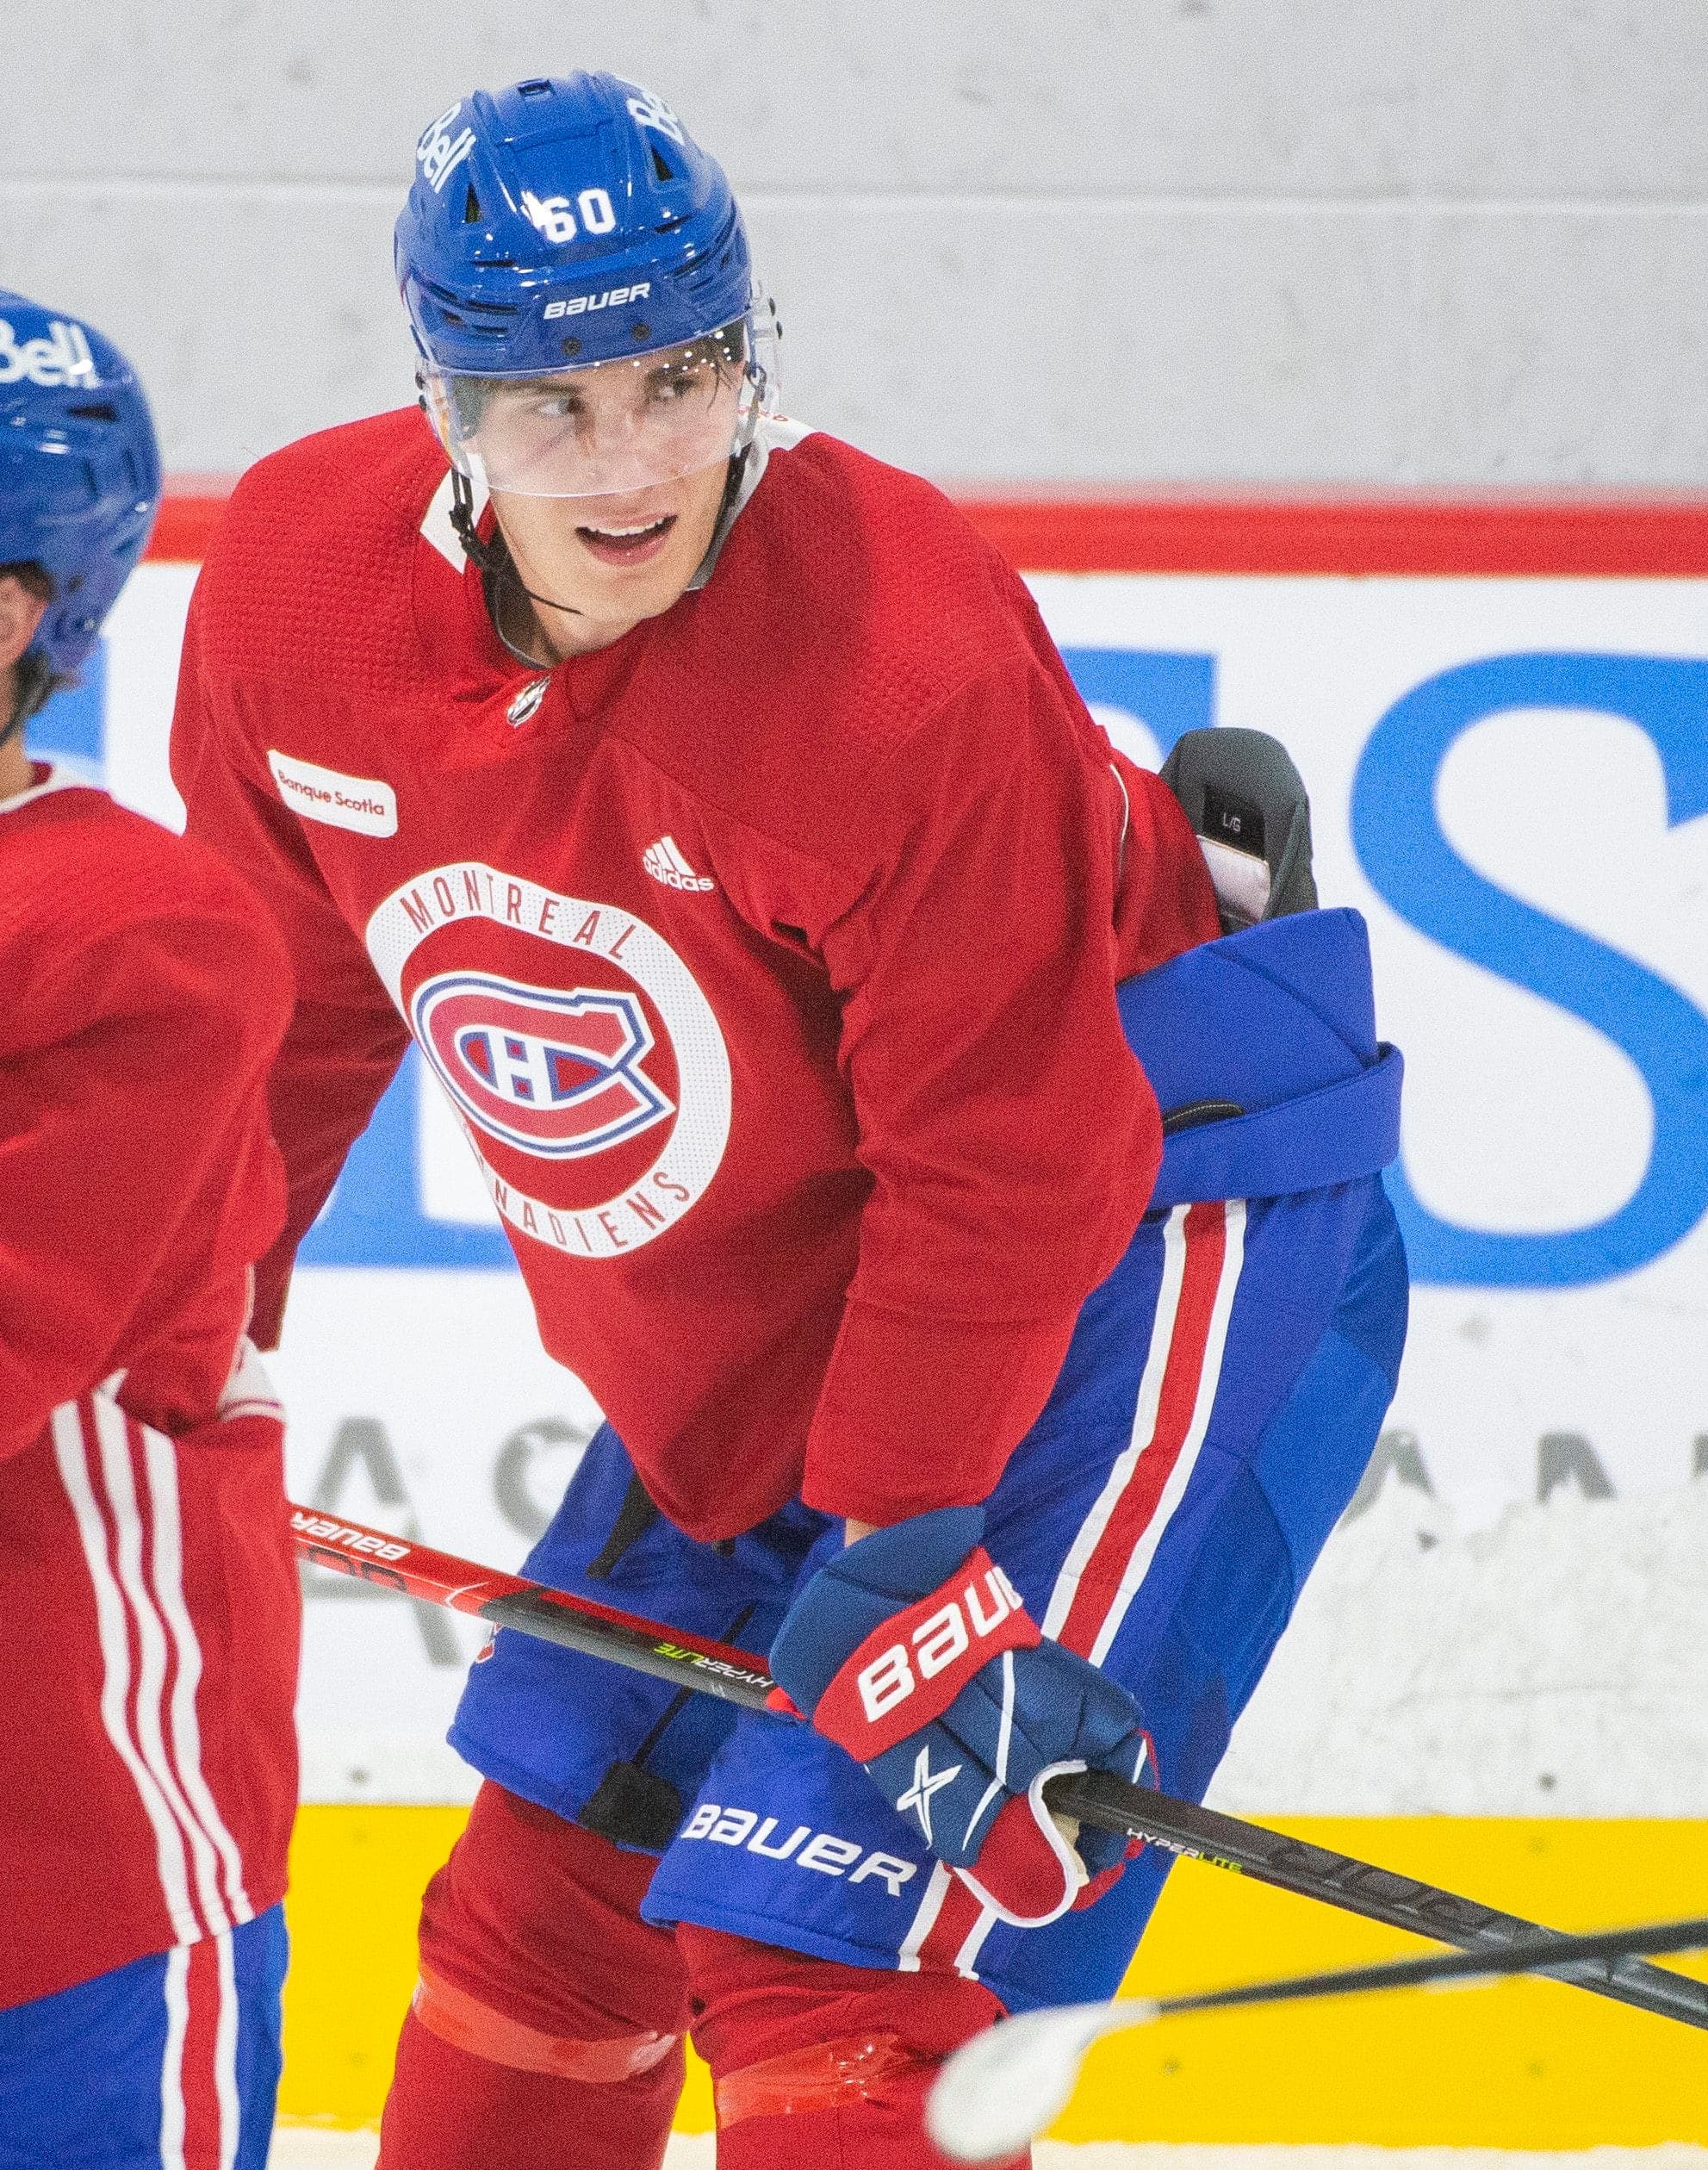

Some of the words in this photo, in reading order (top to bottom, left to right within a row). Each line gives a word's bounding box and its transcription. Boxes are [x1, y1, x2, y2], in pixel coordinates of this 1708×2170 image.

[416, 102, 477, 194] Bell
[539, 187, 617, 245] 60
[277, 769, 332, 803] Banque
[334, 790, 385, 816] Scotia
[642, 854, 715, 892] adidas
[399, 870, 636, 961] MONTREAL
[482, 1160, 690, 1253] NADIENS
